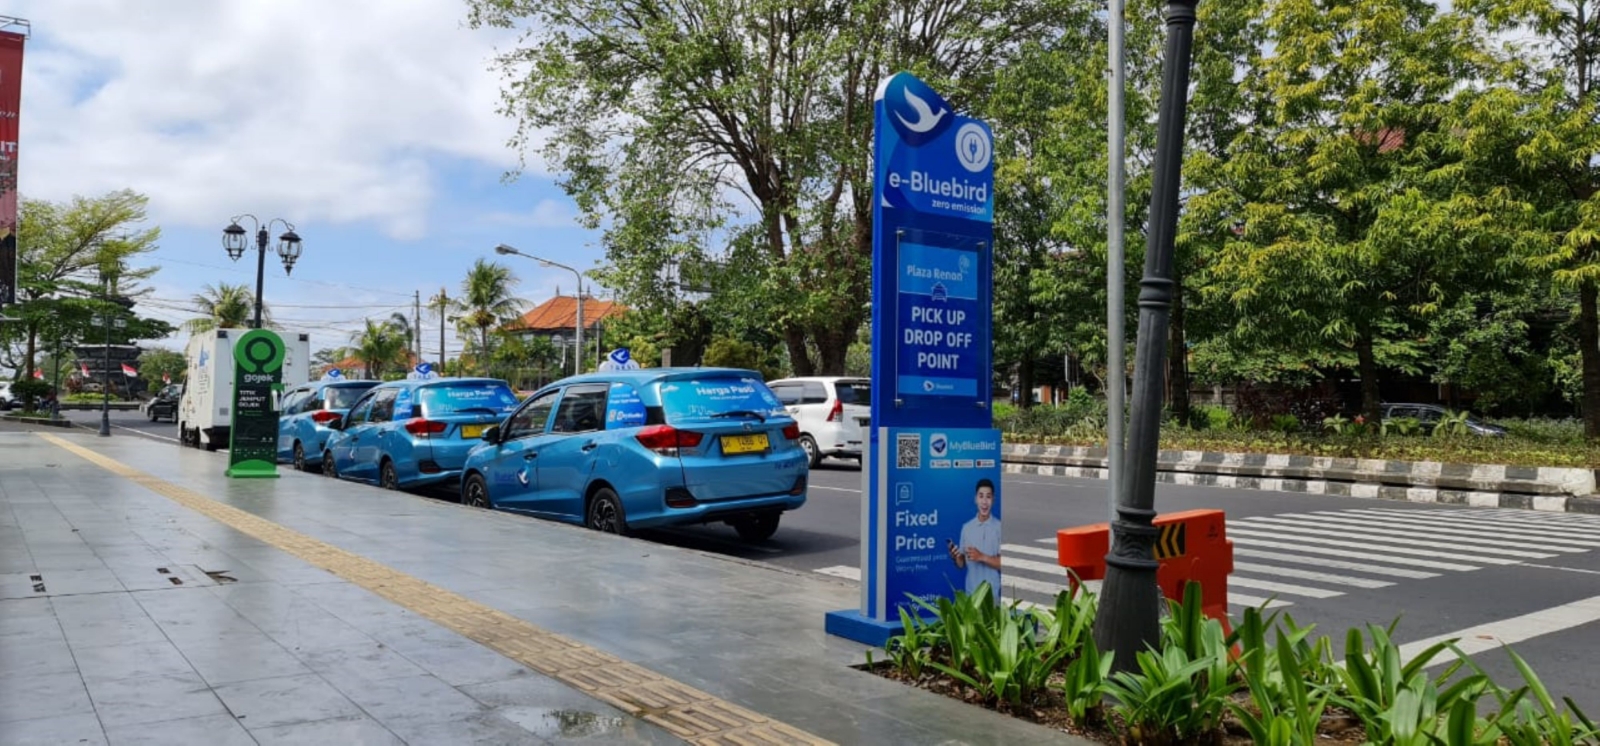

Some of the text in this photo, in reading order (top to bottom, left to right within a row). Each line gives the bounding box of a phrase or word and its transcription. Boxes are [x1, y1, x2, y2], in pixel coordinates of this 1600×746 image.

[888, 171, 987, 202] e-Bluebird
[932, 199, 987, 215] zero emission
[906, 264, 963, 281] Plaza Renon
[911, 306, 966, 325] PICK UP
[904, 328, 972, 348] DROP OFF
[917, 352, 960, 370] POINT
[244, 374, 274, 384] gojek
[949, 441, 996, 453] MyBlueBird
[895, 509, 938, 527] Fixed
[895, 533, 936, 551] Price
